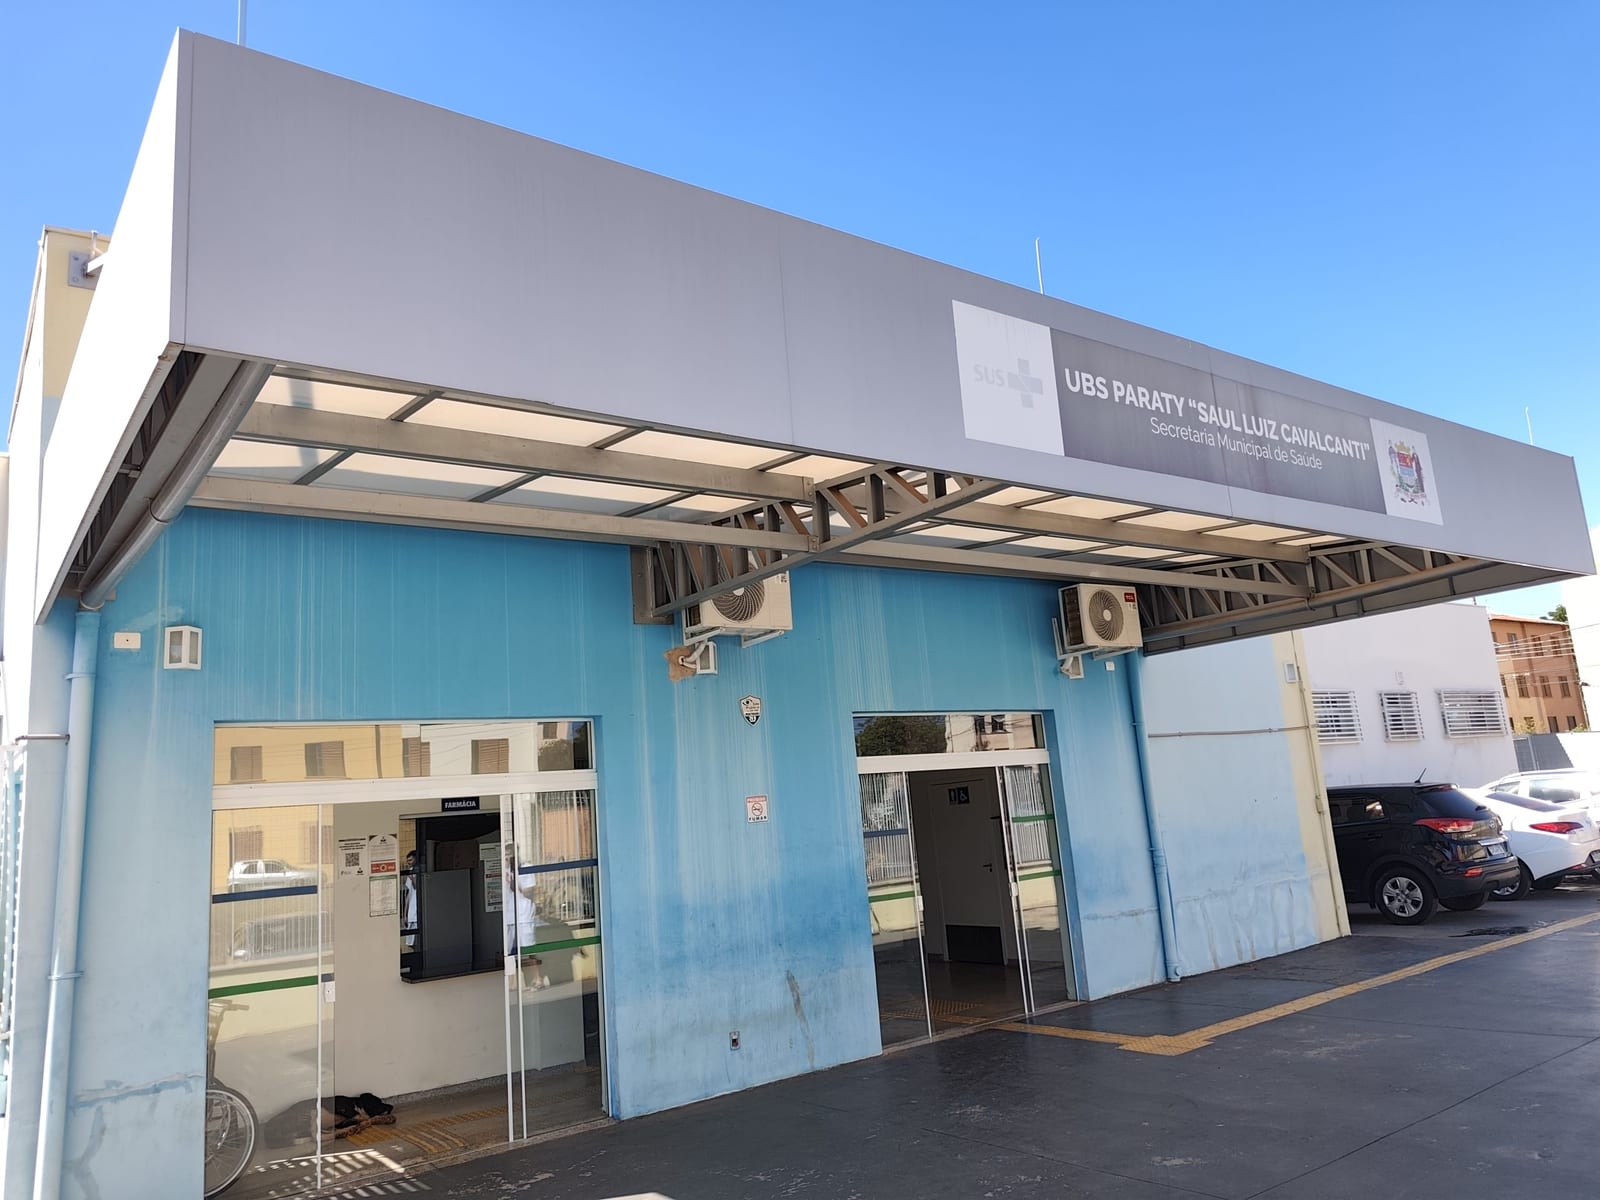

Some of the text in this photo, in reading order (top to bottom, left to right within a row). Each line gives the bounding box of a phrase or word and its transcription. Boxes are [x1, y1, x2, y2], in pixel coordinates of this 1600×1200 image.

[973, 364, 1005, 386] SUS
[1065, 368, 1370, 460] UBS PARATY “SAUL LUIZ CAVALCANTI”
[1150, 417, 1322, 469] Secretaria Municipal de Saúde
[445, 800, 476, 808] FARMÁCIA
